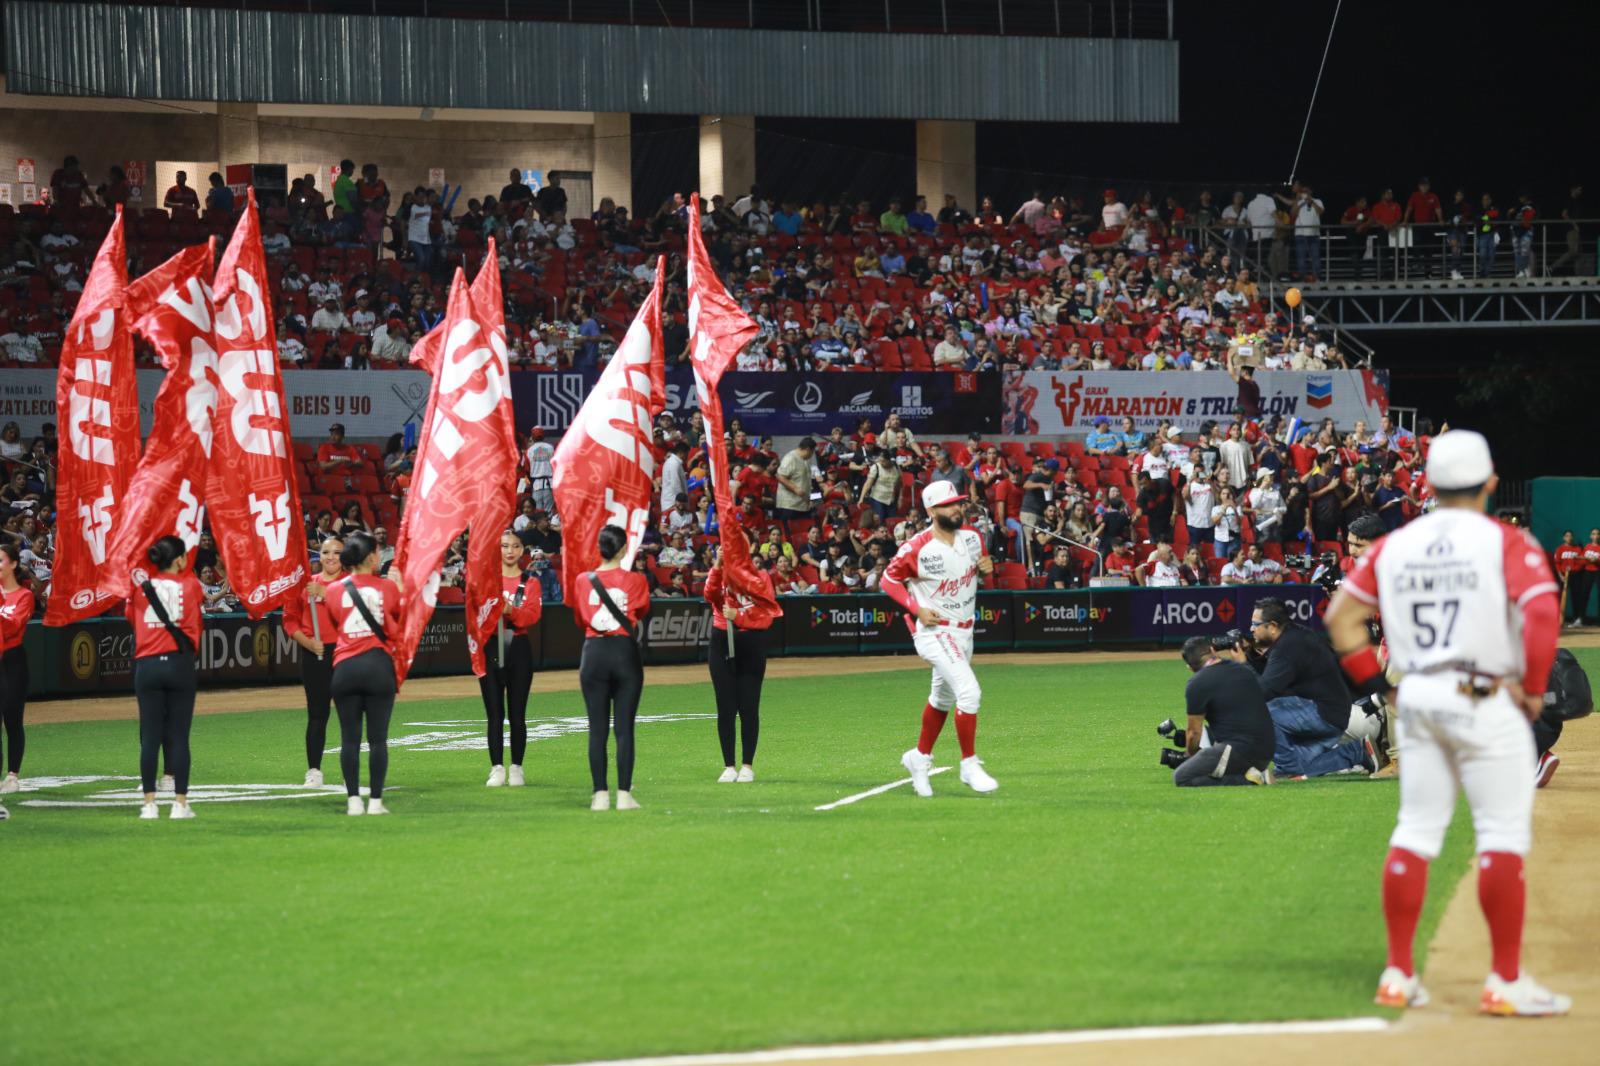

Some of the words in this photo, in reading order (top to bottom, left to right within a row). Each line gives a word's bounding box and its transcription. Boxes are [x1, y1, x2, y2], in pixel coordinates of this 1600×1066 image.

[1085, 387, 1109, 395] GRAN
[293, 395, 330, 415] BEIS
[839, 404, 882, 413] ARCANGEL
[891, 406, 934, 416] CERRITOS
[1081, 391, 1184, 416] MARATÓN
[1186, 399, 1197, 415] &
[1200, 391, 1298, 415] TRILÓN
[920, 553, 943, 563] Mobil
[829, 607, 894, 628] Totalplay
[1043, 604, 1108, 623] Totalpay
[1152, 601, 1214, 625] ARCO
[431, 624, 464, 634] ACUARIO
[1412, 599, 1460, 650] 57
